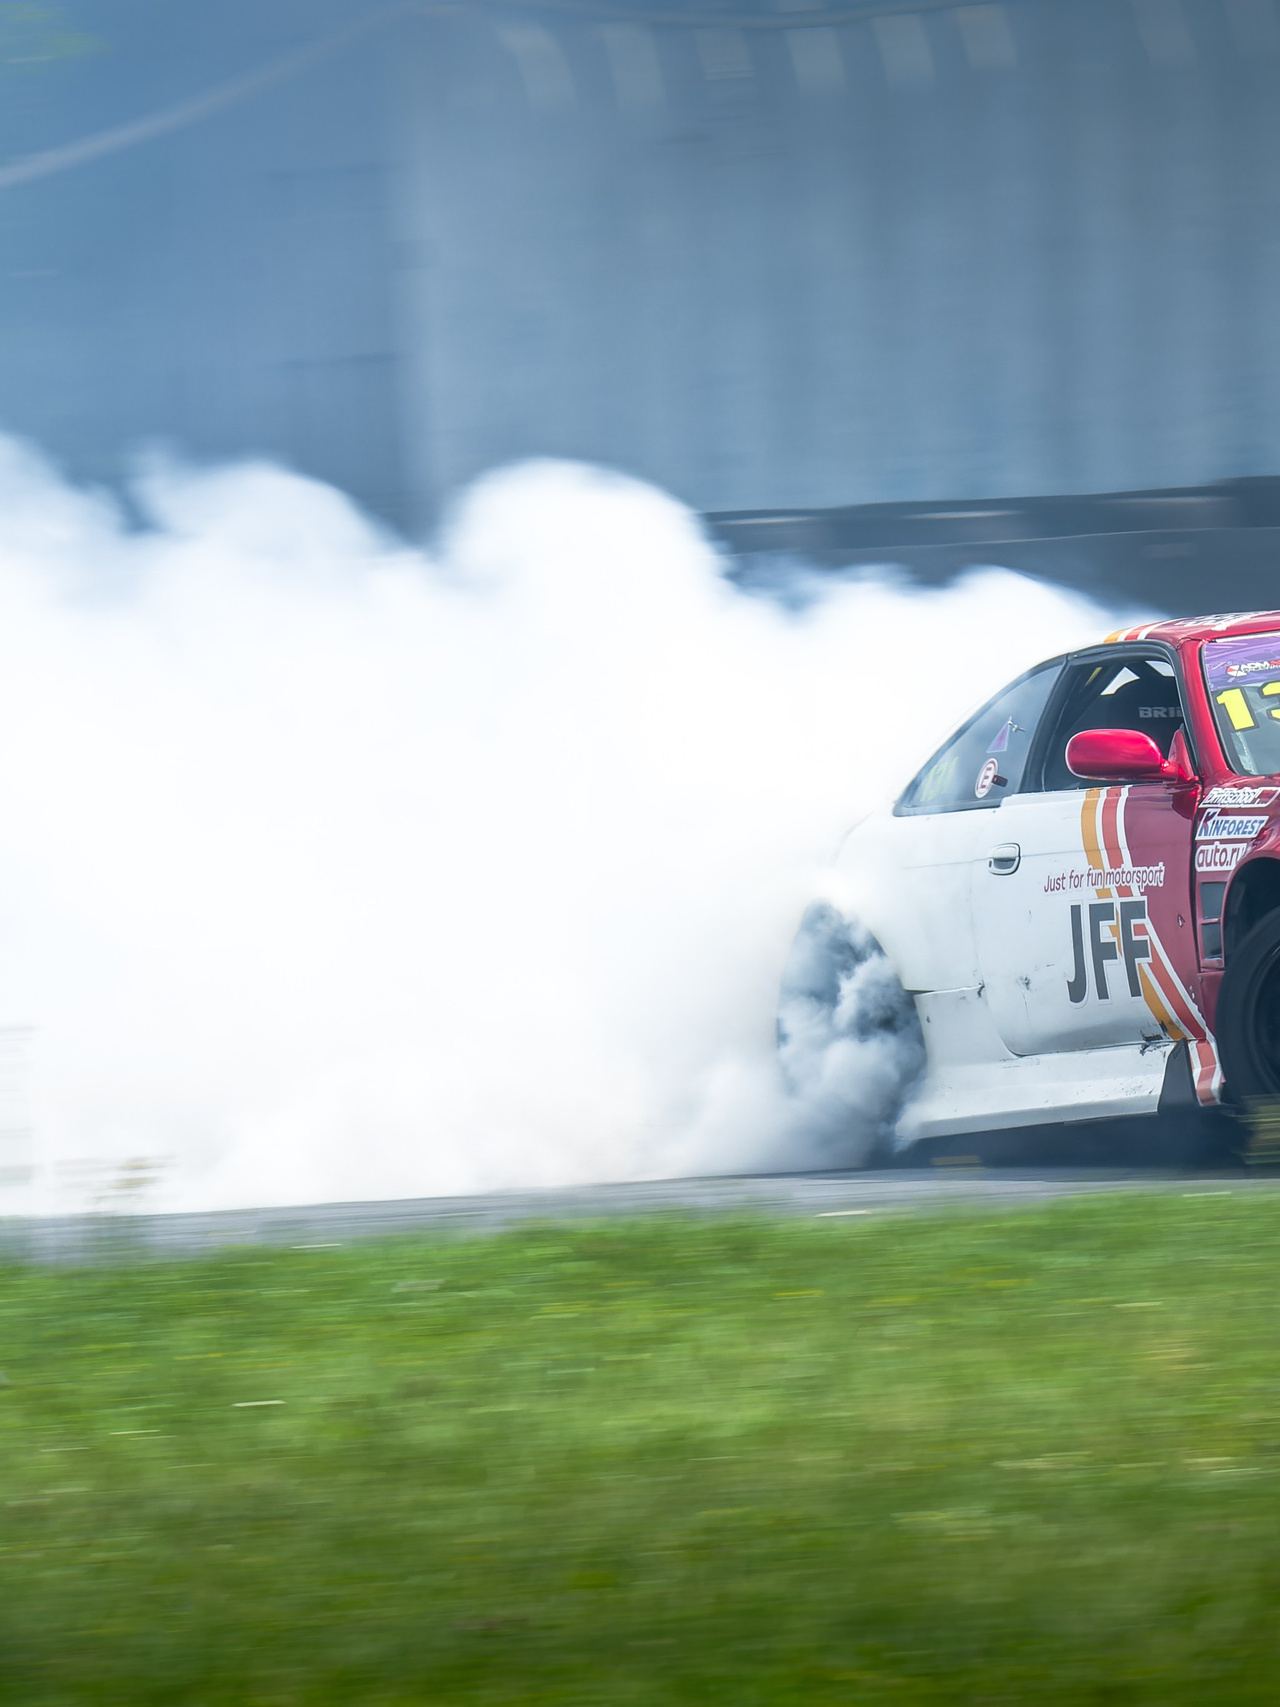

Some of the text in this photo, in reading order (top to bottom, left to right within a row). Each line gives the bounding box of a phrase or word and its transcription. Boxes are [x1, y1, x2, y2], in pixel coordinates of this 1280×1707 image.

[1198, 811, 1265, 837] KINFOREST
[1043, 865, 1164, 893] Just for fun motorsport
[1066, 900, 1152, 1004] JFF
